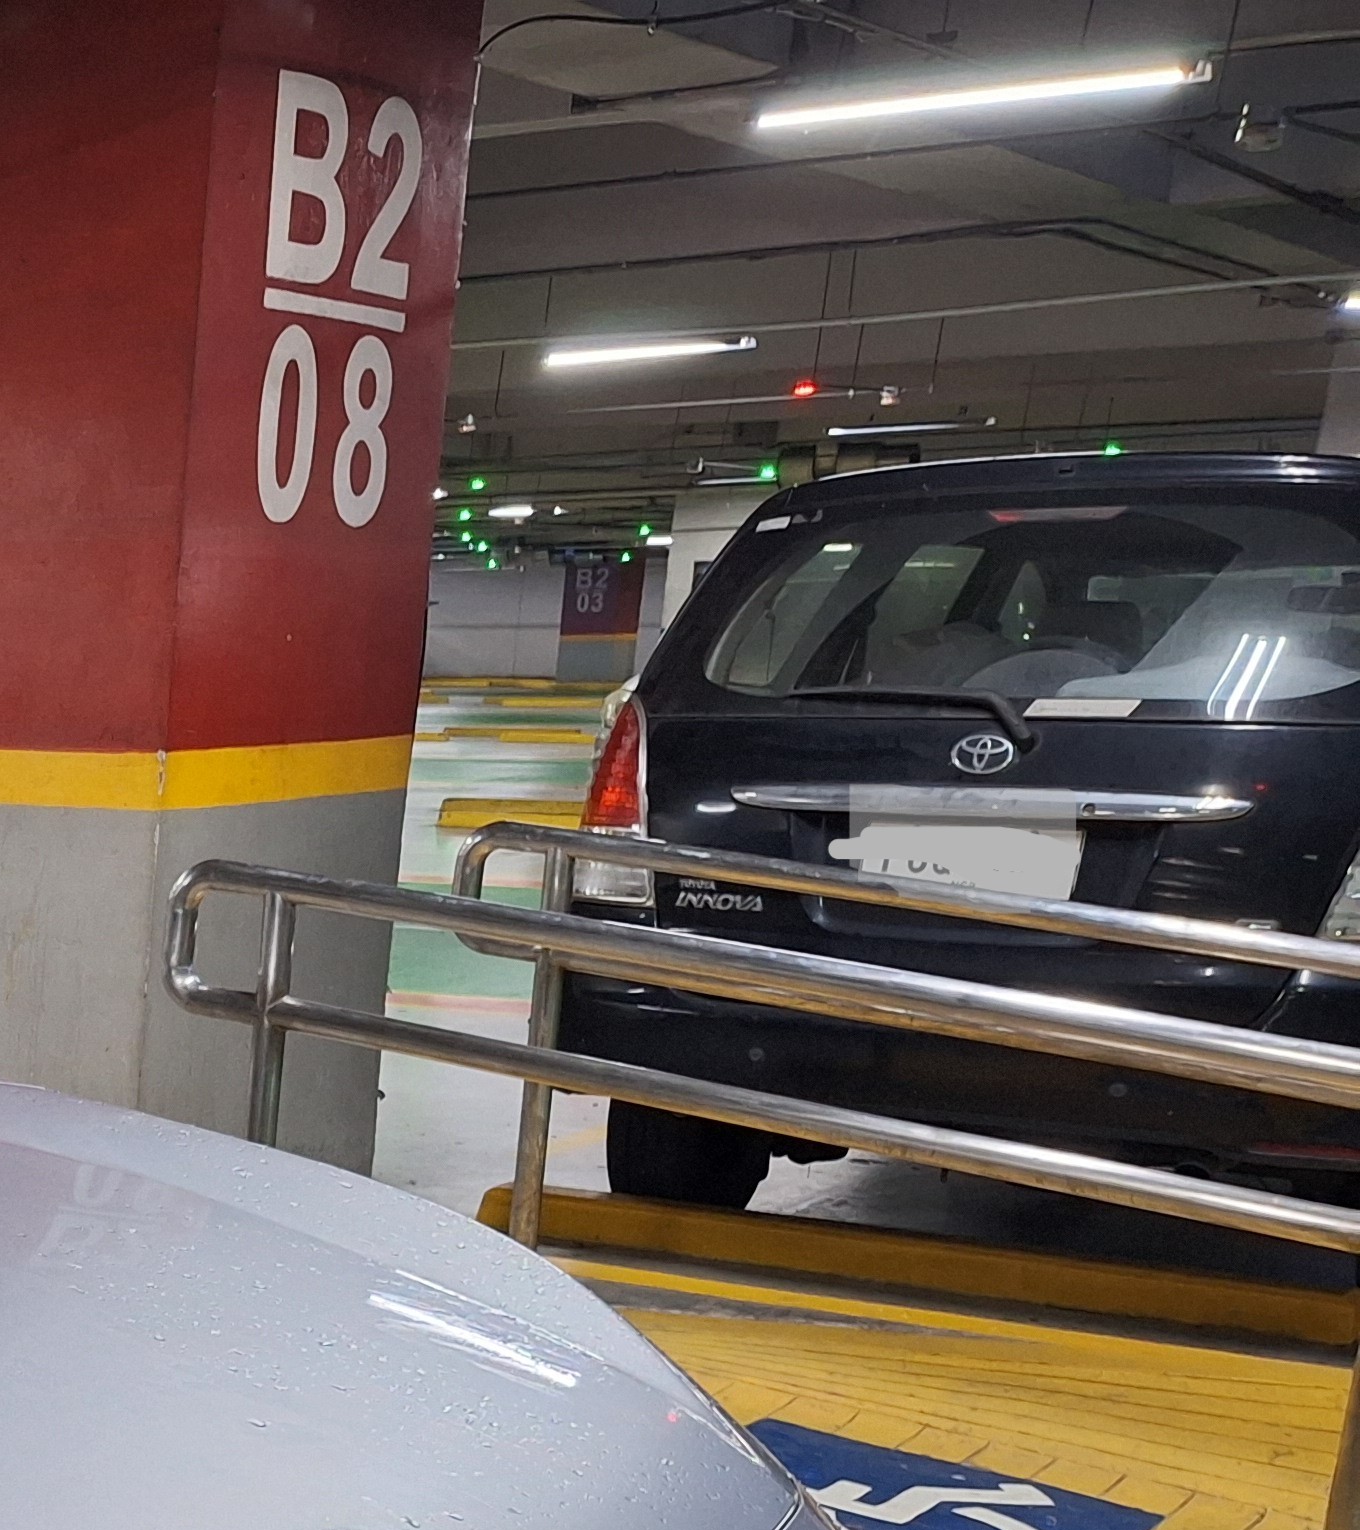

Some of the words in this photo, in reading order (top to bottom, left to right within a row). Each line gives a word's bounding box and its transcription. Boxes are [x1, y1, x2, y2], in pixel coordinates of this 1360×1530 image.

[265, 69, 423, 300] B2
[257, 324, 393, 528] 08
[576, 567, 609, 589] B2
[576, 591, 604, 613] 03
[675, 891, 763, 912] INNOVA
